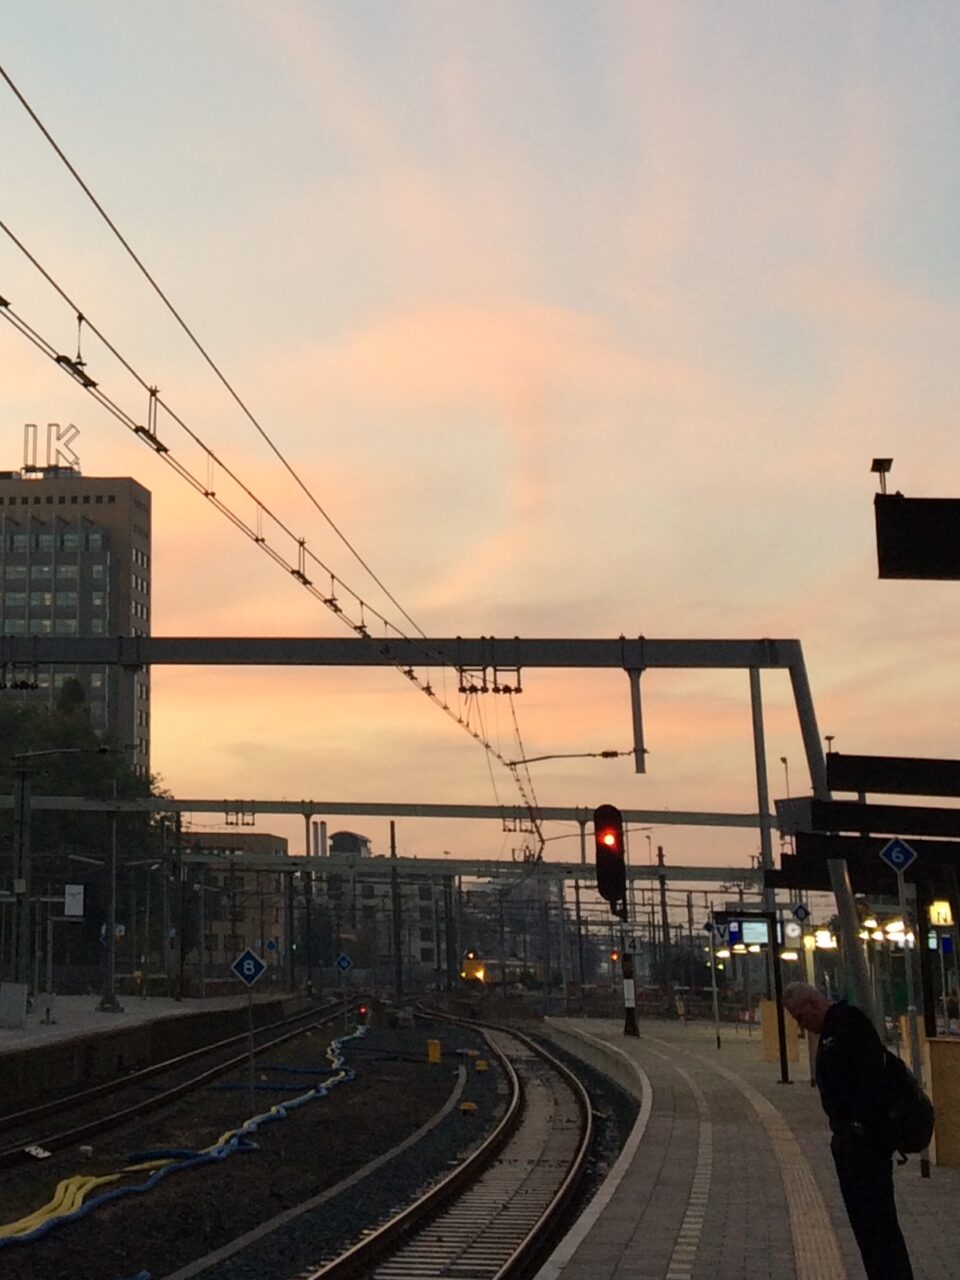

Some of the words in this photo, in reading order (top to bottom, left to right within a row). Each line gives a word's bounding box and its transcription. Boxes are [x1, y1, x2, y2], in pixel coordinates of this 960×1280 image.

[892, 848, 904, 863] 6
[937, 911, 947, 923] N
[716, 926, 727, 938] V
[243, 959, 255, 975] 8
